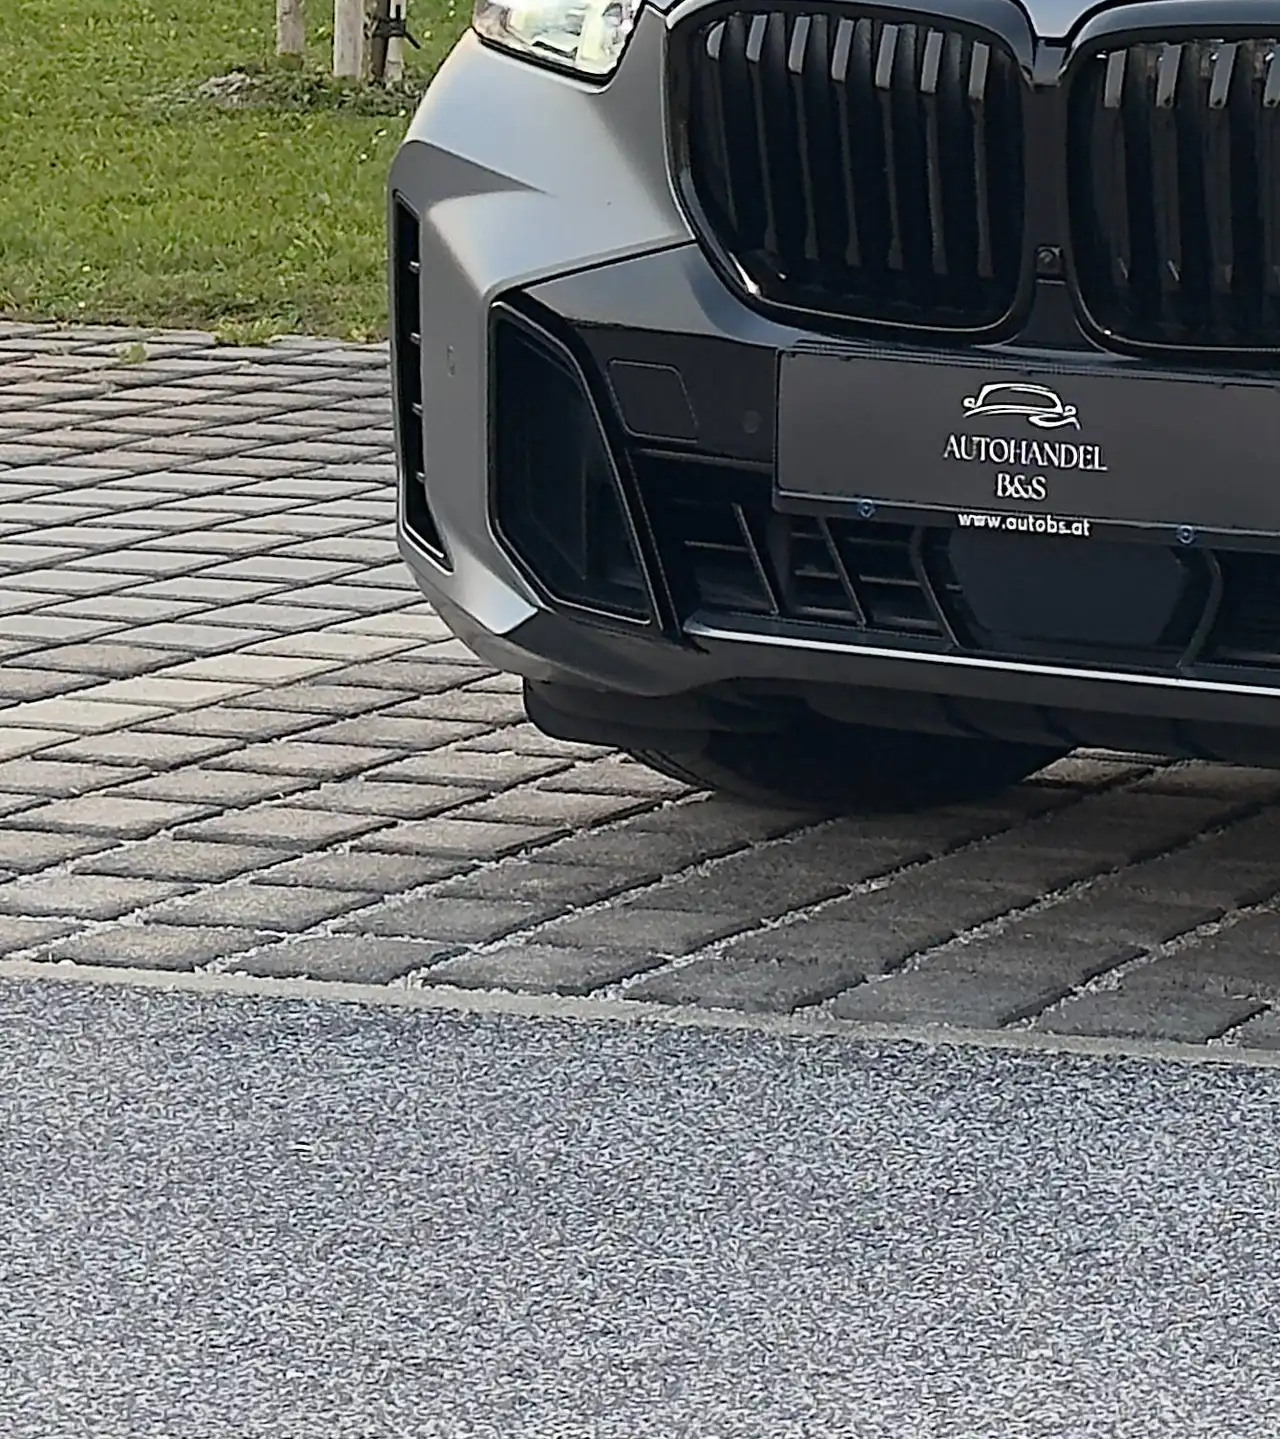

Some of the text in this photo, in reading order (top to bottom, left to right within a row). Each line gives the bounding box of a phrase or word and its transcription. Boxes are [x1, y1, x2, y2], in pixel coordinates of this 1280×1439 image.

[943, 433, 1108, 471] AUTOHANDEL
[996, 472, 1047, 501] B&S
[957, 512, 1091, 537] www.autobs.at
